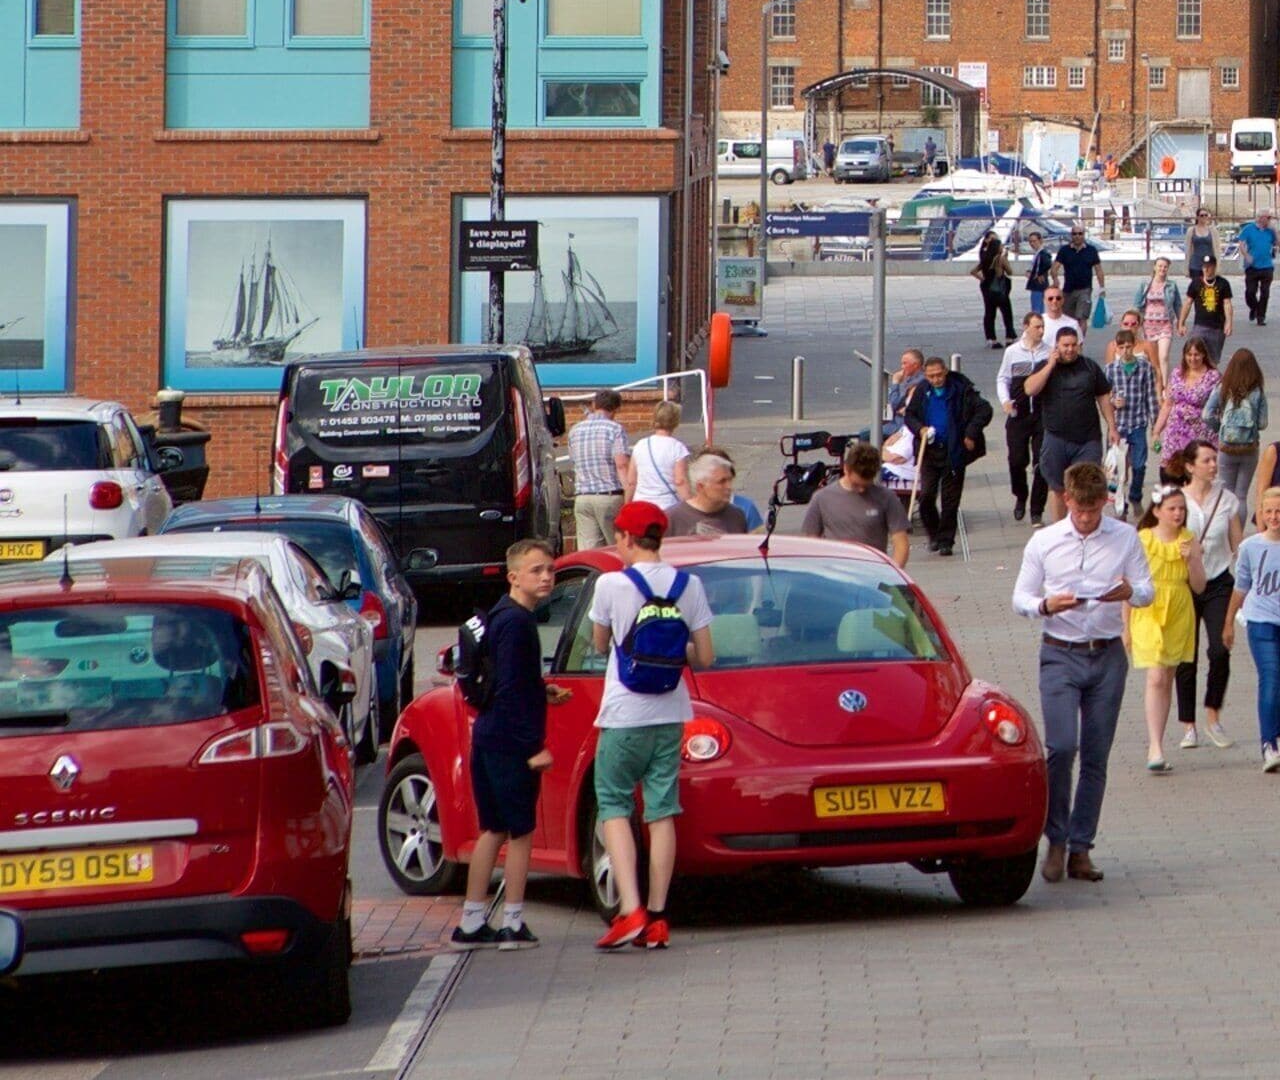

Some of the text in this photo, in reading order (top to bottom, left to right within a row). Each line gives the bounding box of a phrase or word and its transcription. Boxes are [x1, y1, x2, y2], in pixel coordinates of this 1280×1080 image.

[492, 230, 509, 239] you
[320, 374, 482, 411] TAYLOR
[341, 398, 482, 412] CONSTRUCTION LTD
[329, 416, 359, 426] 01452
[8, 544, 34, 557] HXG
[825, 786, 933, 813] SU51 VZZ
[15, 806, 117, 825] SCENIC
[1, 857, 75, 887] DY59
